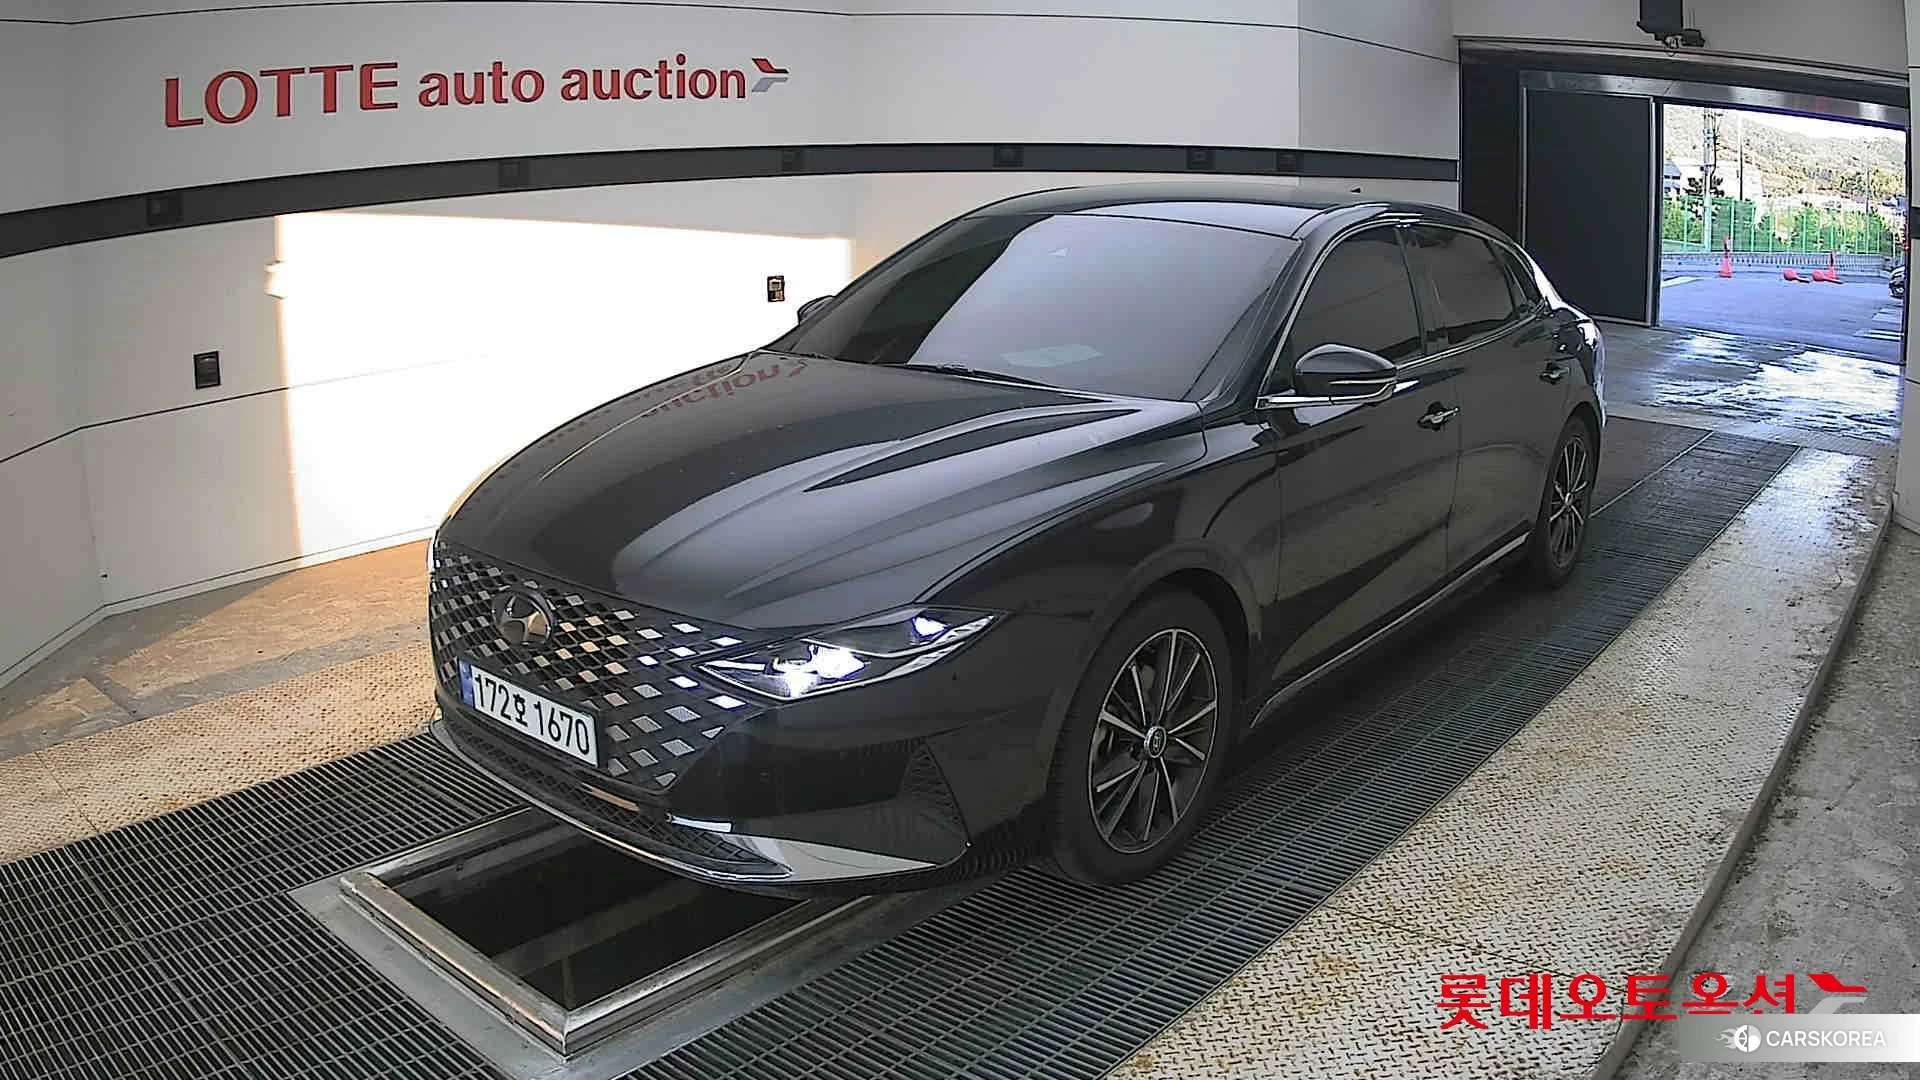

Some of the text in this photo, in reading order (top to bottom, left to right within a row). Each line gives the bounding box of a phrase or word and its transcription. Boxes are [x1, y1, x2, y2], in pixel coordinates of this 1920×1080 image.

[164, 53, 746, 128] LOTTE auto auction
[533, 700, 590, 756] 1670
